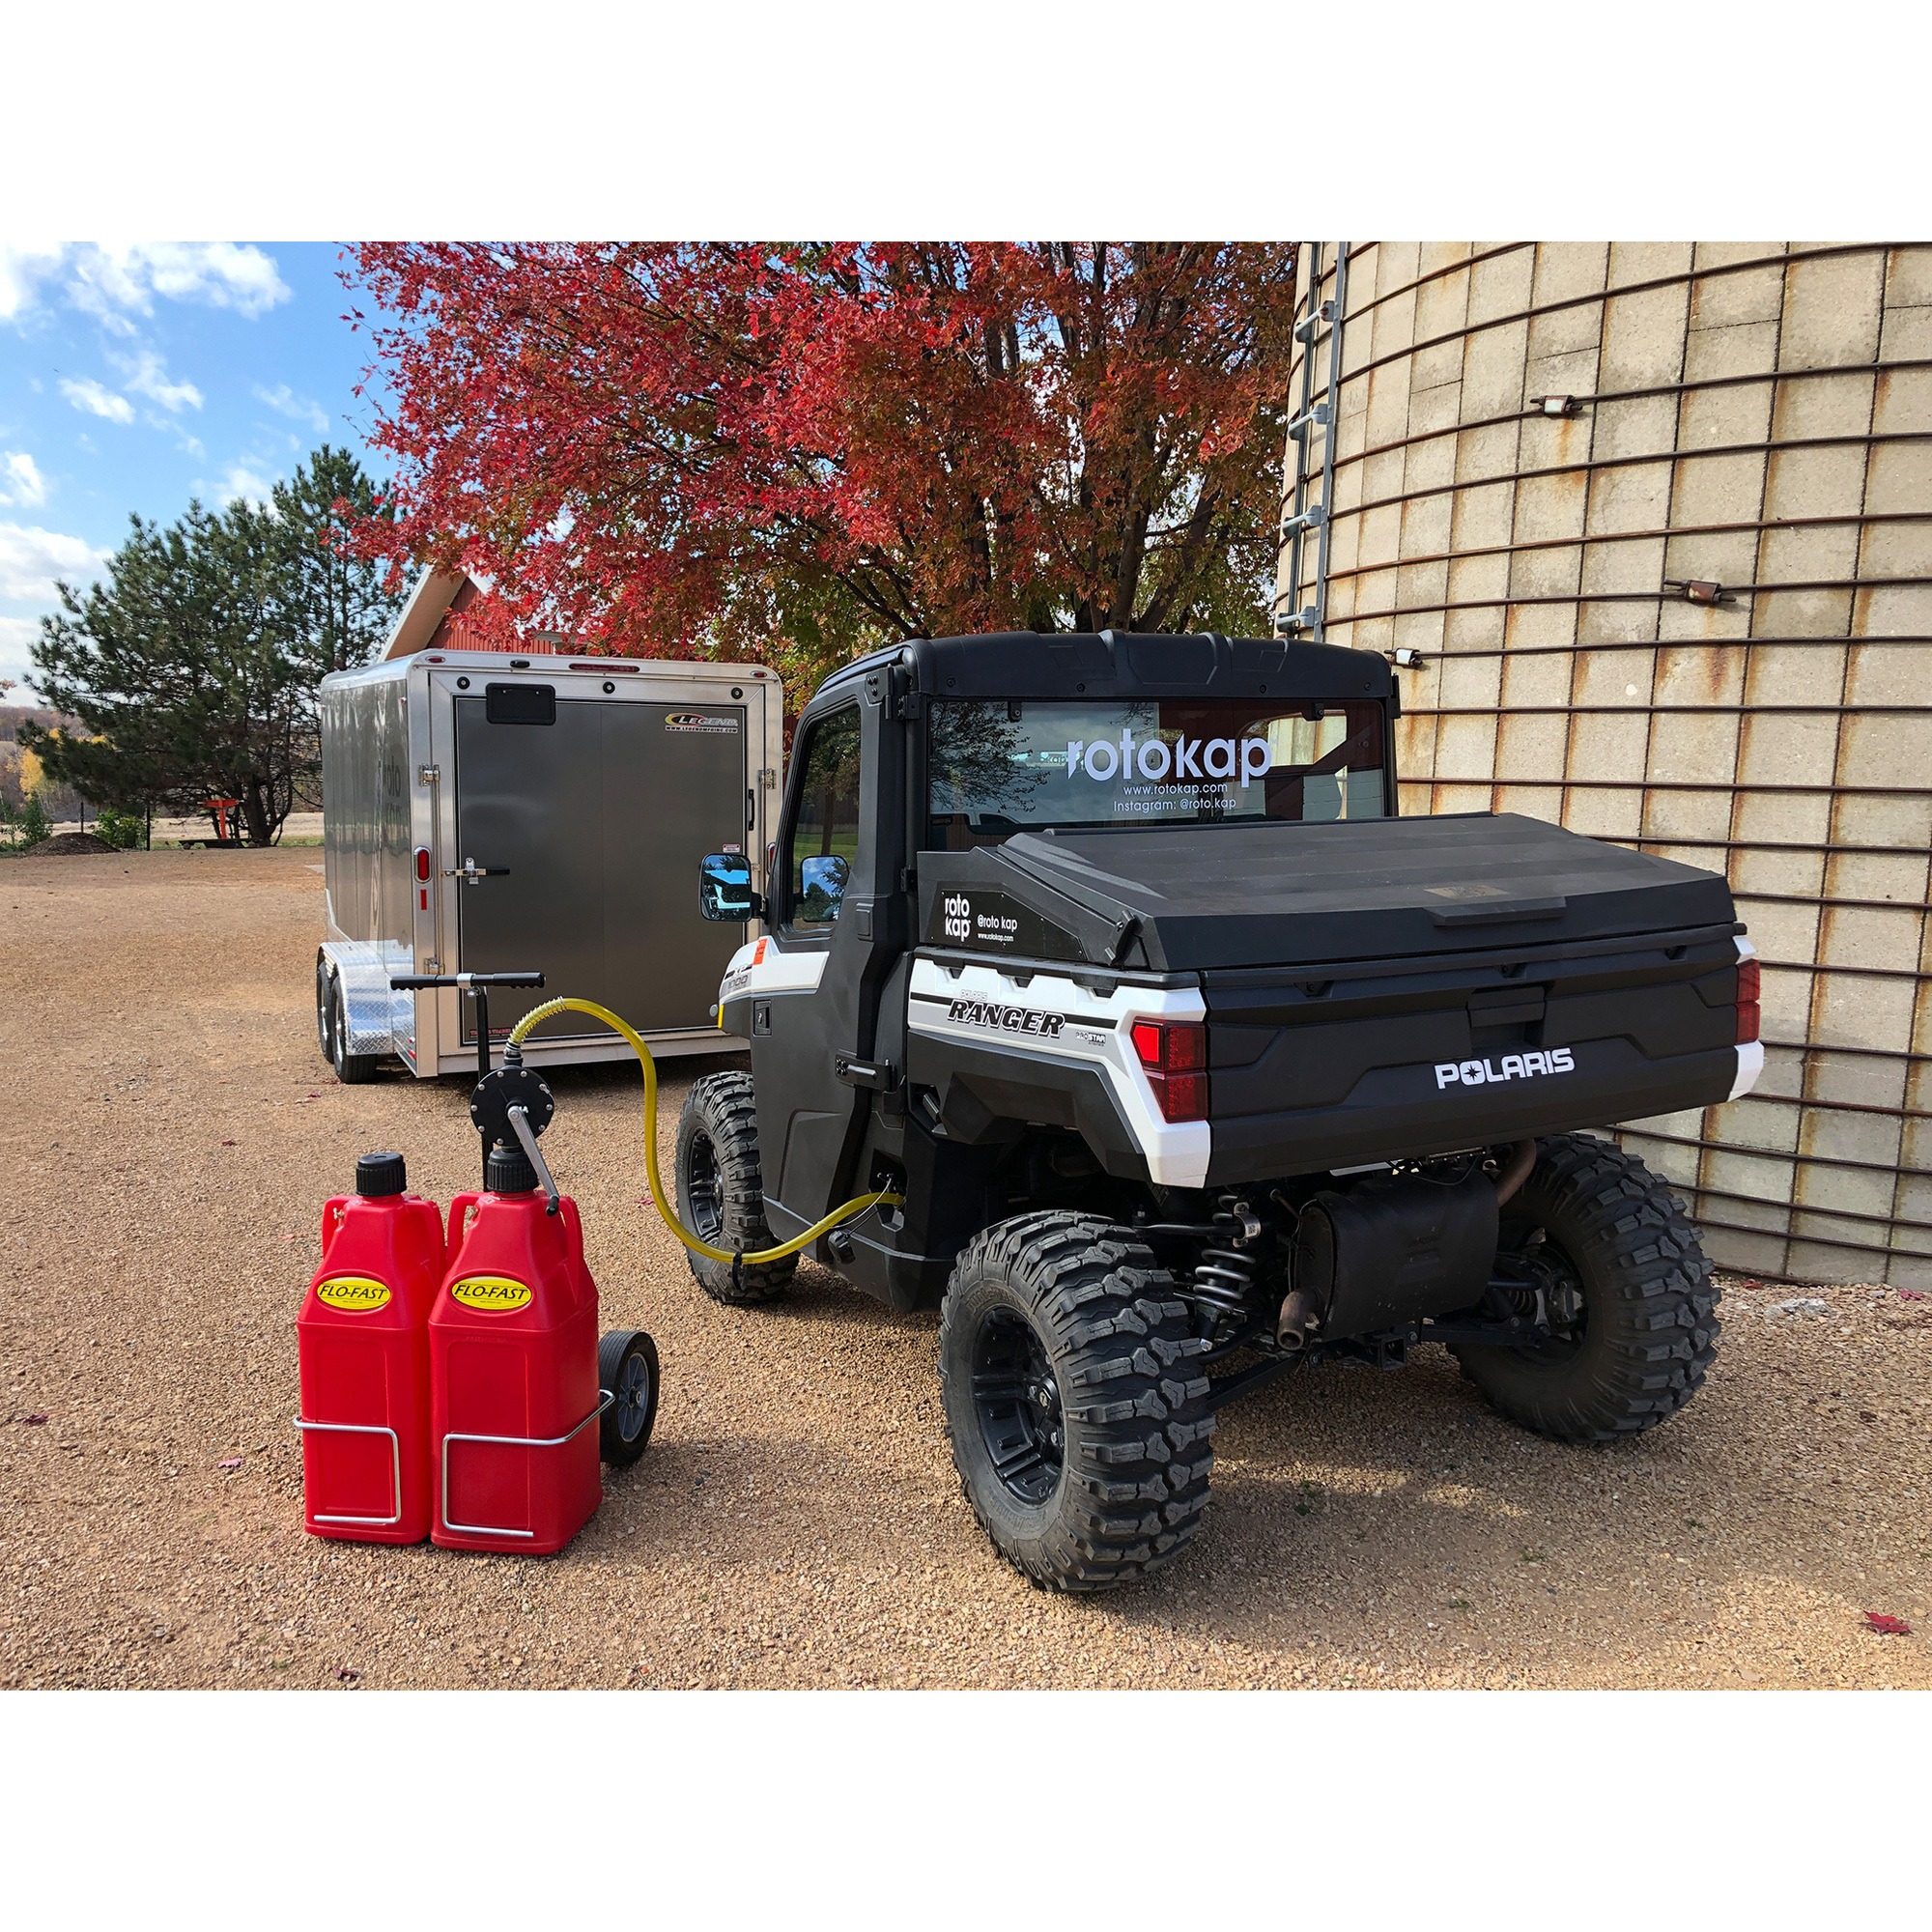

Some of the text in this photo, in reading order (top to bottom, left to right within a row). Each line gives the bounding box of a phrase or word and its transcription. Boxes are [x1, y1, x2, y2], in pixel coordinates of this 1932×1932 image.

[678, 716, 738, 727] LEGEND
[1067, 728, 1272, 788] rotokap
[1122, 782, 1228, 797] www.rotokap.com
[1114, 798, 1236, 813] Instagram: @roto.kap
[945, 894, 970, 917] roto
[945, 916, 971, 942] kap
[978, 914, 1018, 932] @roto kap
[960, 988, 988, 1001] POLARIS
[948, 999, 1065, 1038] RANGER
[1435, 1047, 1576, 1090] POLARIS
[320, 1285, 387, 1299] FLO-FAST
[454, 1284, 527, 1300] FLO-FAST
